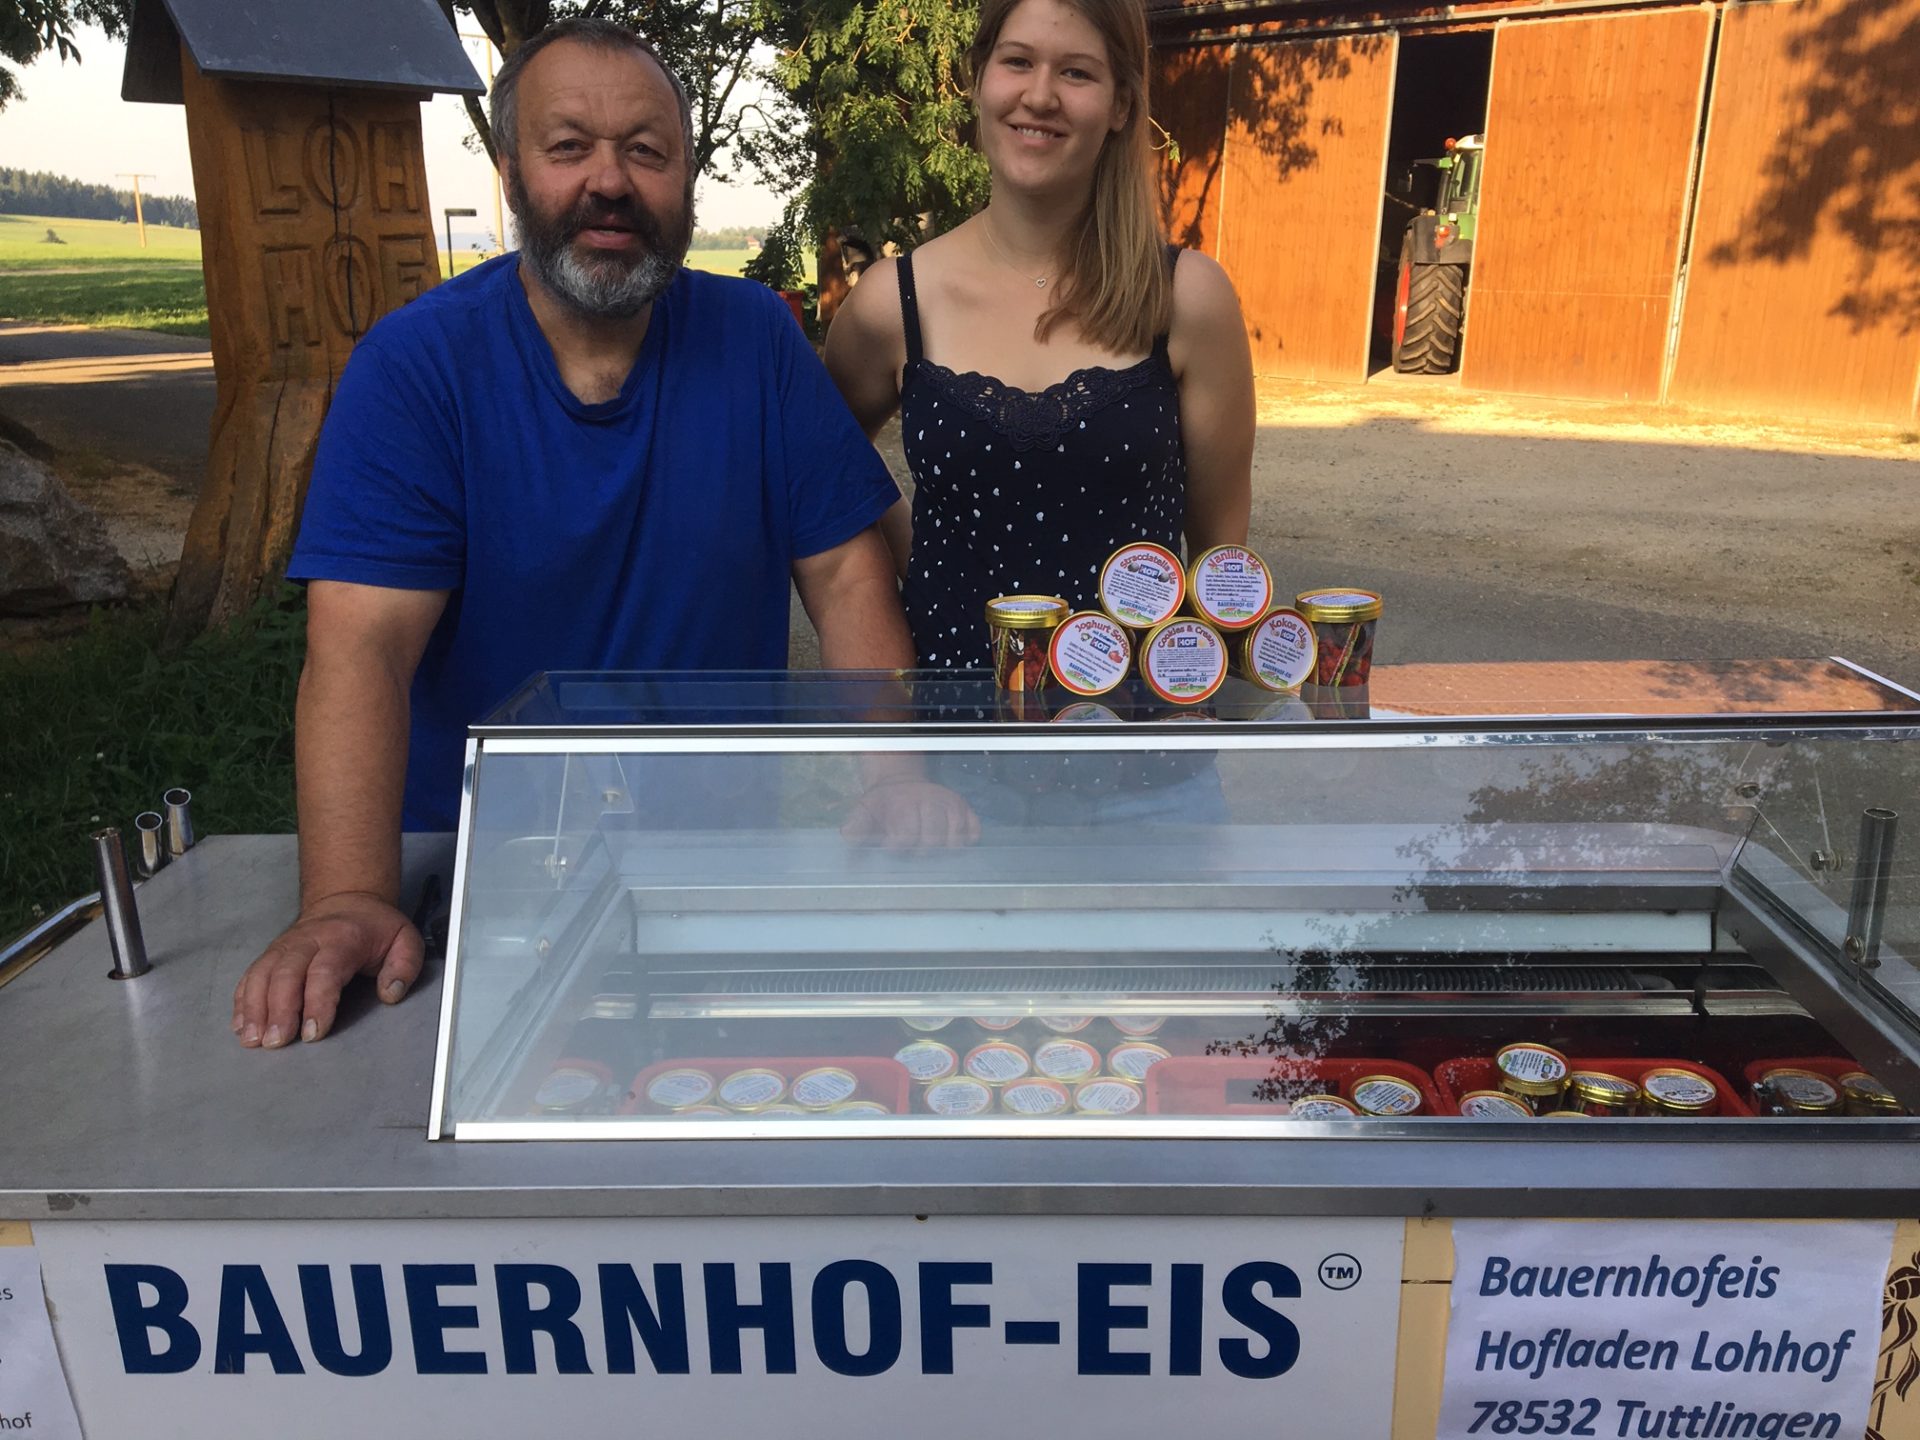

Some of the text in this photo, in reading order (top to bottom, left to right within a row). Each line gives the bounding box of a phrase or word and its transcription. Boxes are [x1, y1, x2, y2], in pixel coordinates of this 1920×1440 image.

[242, 115, 421, 221] LOH
[1120, 553, 1178, 585] Stracciatella Eis
[1207, 549, 1261, 570] Vanille Eis
[1075, 620, 1111, 633] Joghurt
[1158, 626, 1185, 648] Cookies
[1195, 626, 1215, 647] Cream
[1269, 617, 1307, 643] Kokos Eis
[1479, 1254, 1780, 1307] Bauernhofeis
[104, 1260, 1301, 1379] BAUERNHOF-EIS
[1475, 1328, 1855, 1382] Hofladen Lohhof
[1467, 1397, 1841, 1439] 78532 Tuttlingen
